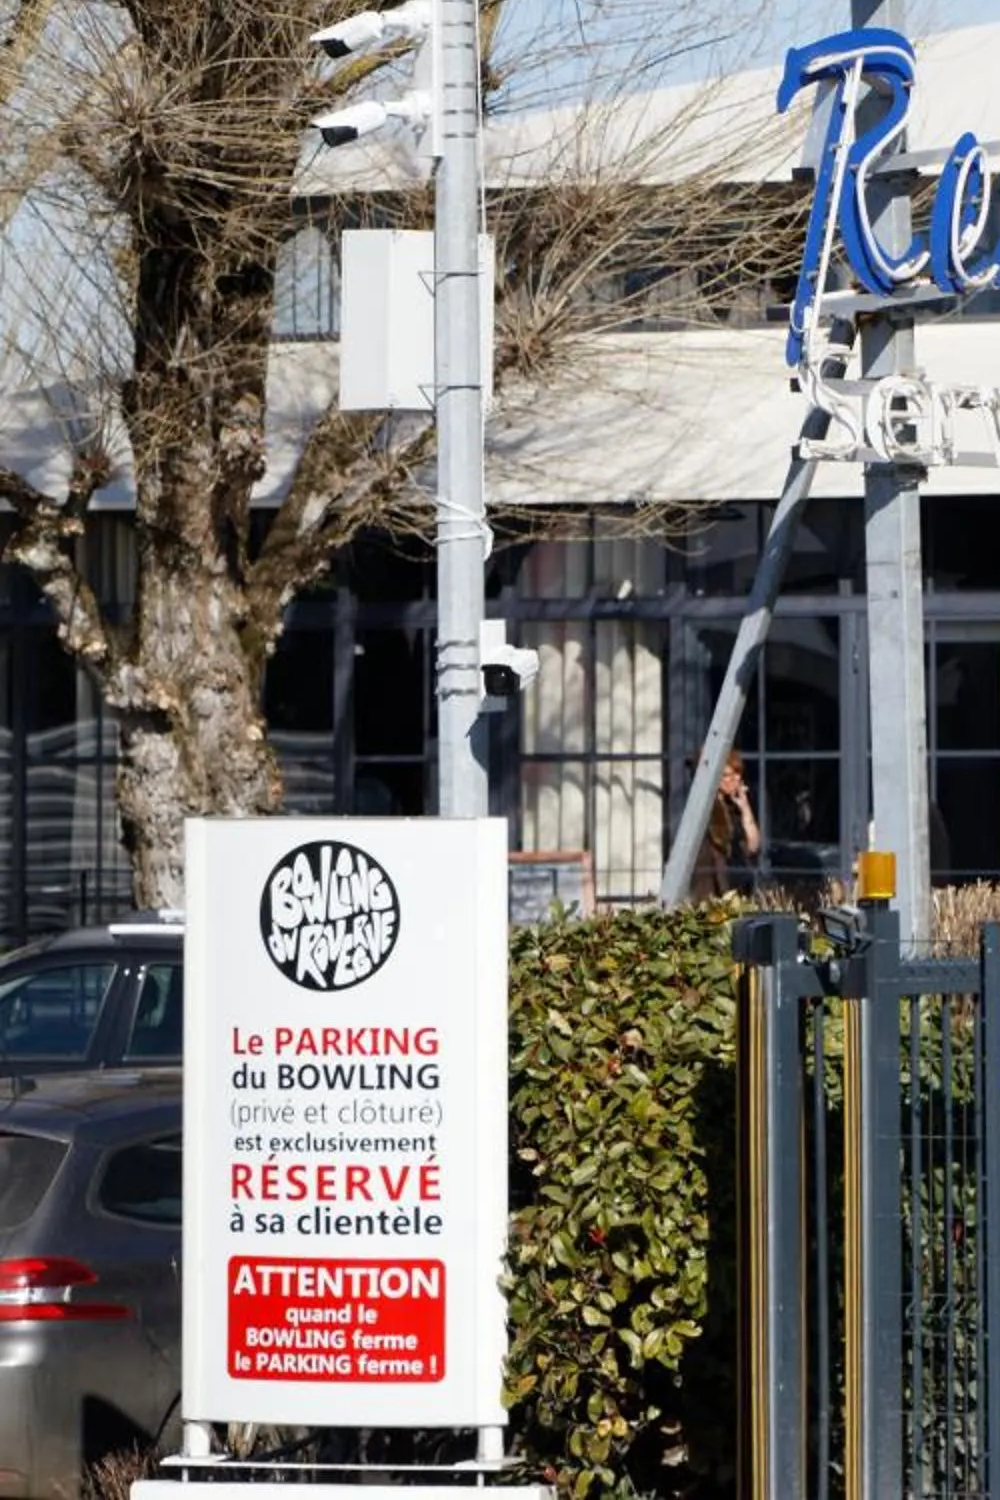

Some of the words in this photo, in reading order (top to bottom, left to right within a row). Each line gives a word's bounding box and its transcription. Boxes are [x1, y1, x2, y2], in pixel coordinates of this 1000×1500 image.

[233, 1028, 263, 1054] Le
[275, 1028, 438, 1055] PARKING
[232, 1063, 265, 1089] du
[278, 1064, 440, 1089] BOWLING
[230, 1100, 295, 1127] (privé
[304, 1104, 328, 1124] et
[338, 1100, 443, 1127] clôturé)
[234, 1134, 262, 1151] est
[269, 1132, 436, 1152] exclusivement
[231, 1155, 441, 1201] RÉSERVÉ
[229, 1204, 245, 1233] à
[255, 1213, 285, 1233] sa
[297, 1207, 443, 1235] clientèle
[233, 1265, 439, 1299] ATTENTION
[285, 1305, 351, 1328] quand
[358, 1304, 378, 1324] le
[245, 1327, 346, 1350] BOWLING
[352, 1329, 417, 1350] ferme
[234, 1352, 250, 1371] le
[256, 1353, 350, 1374] PARKING
[358, 1355, 423, 1376] ferme
